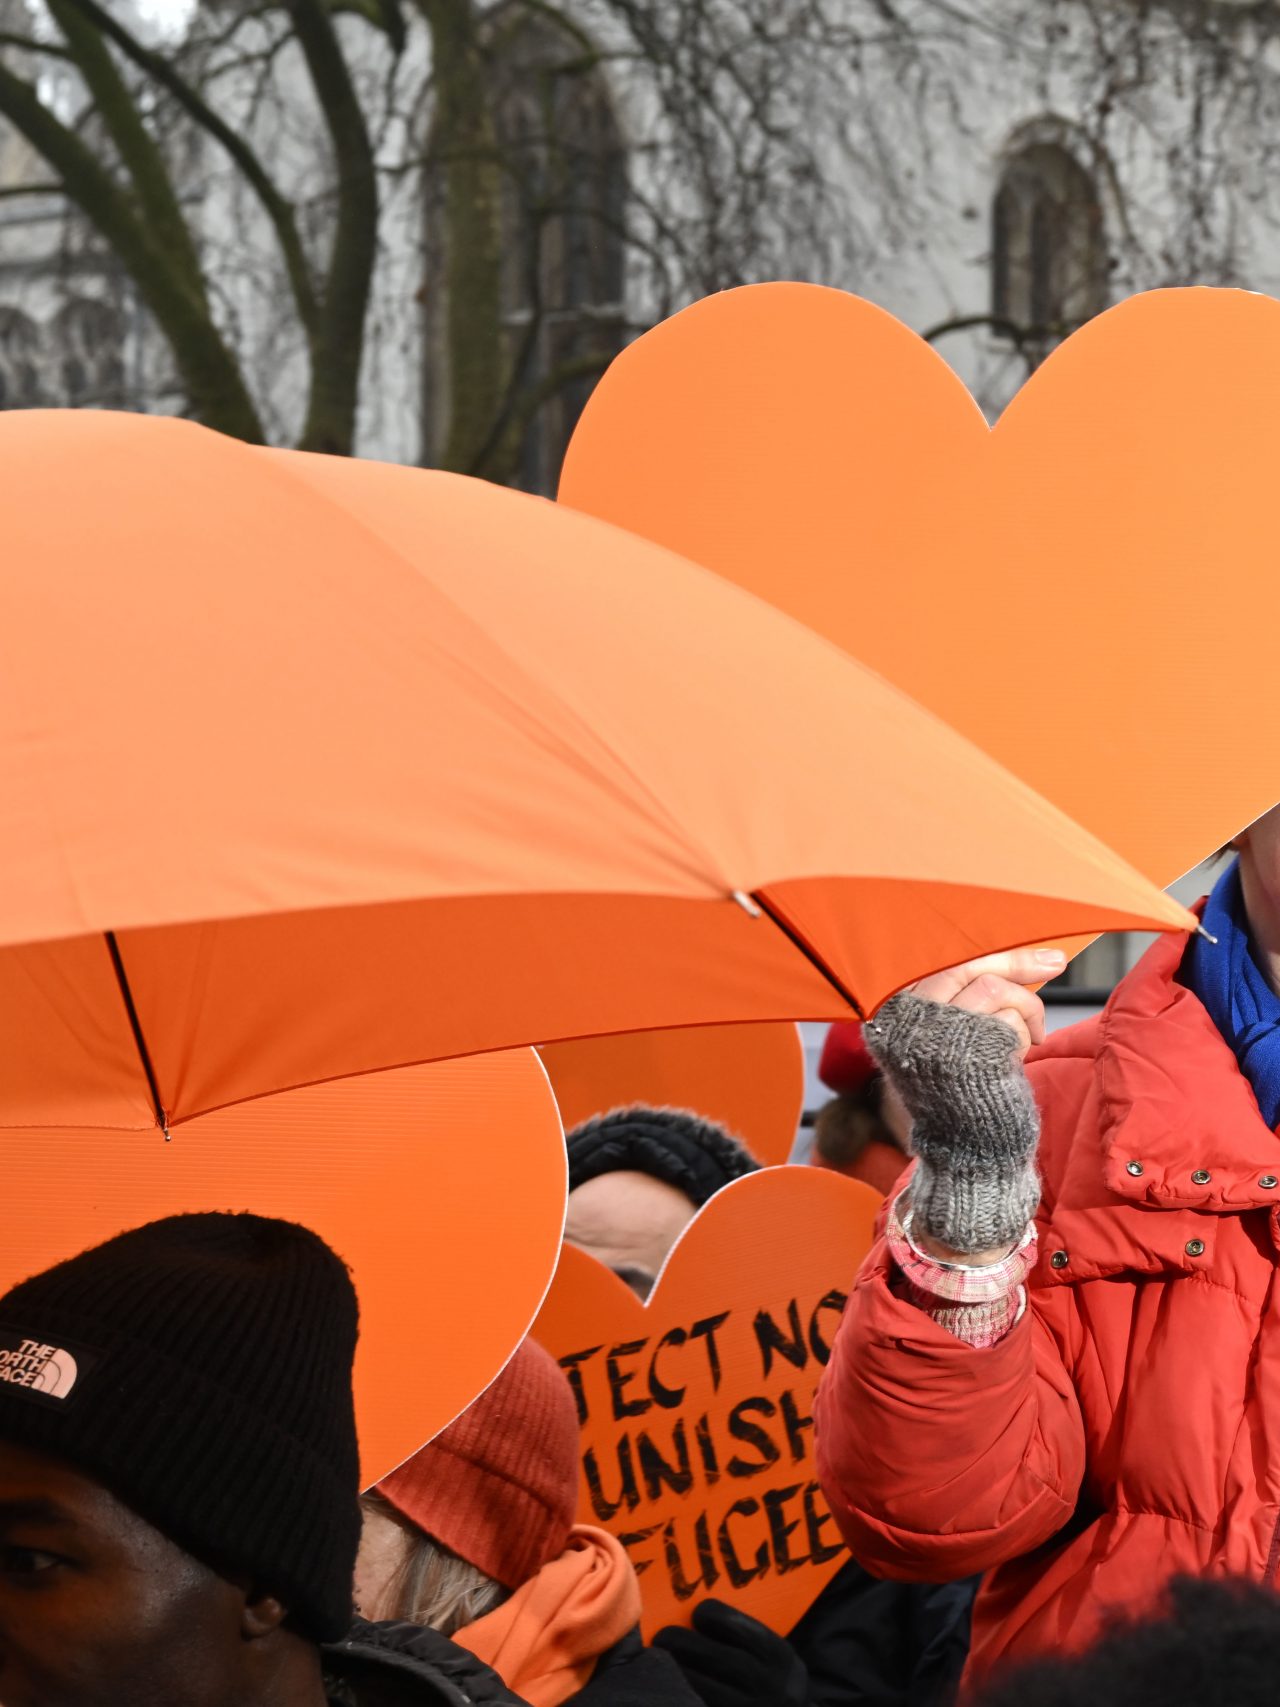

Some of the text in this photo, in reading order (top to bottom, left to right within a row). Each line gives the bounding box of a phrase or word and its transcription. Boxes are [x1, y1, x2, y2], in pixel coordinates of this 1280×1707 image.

[19, 1340, 57, 1360] THE
[0, 1365, 38, 1388] ACE
[558, 1311, 731, 1428] TECT
